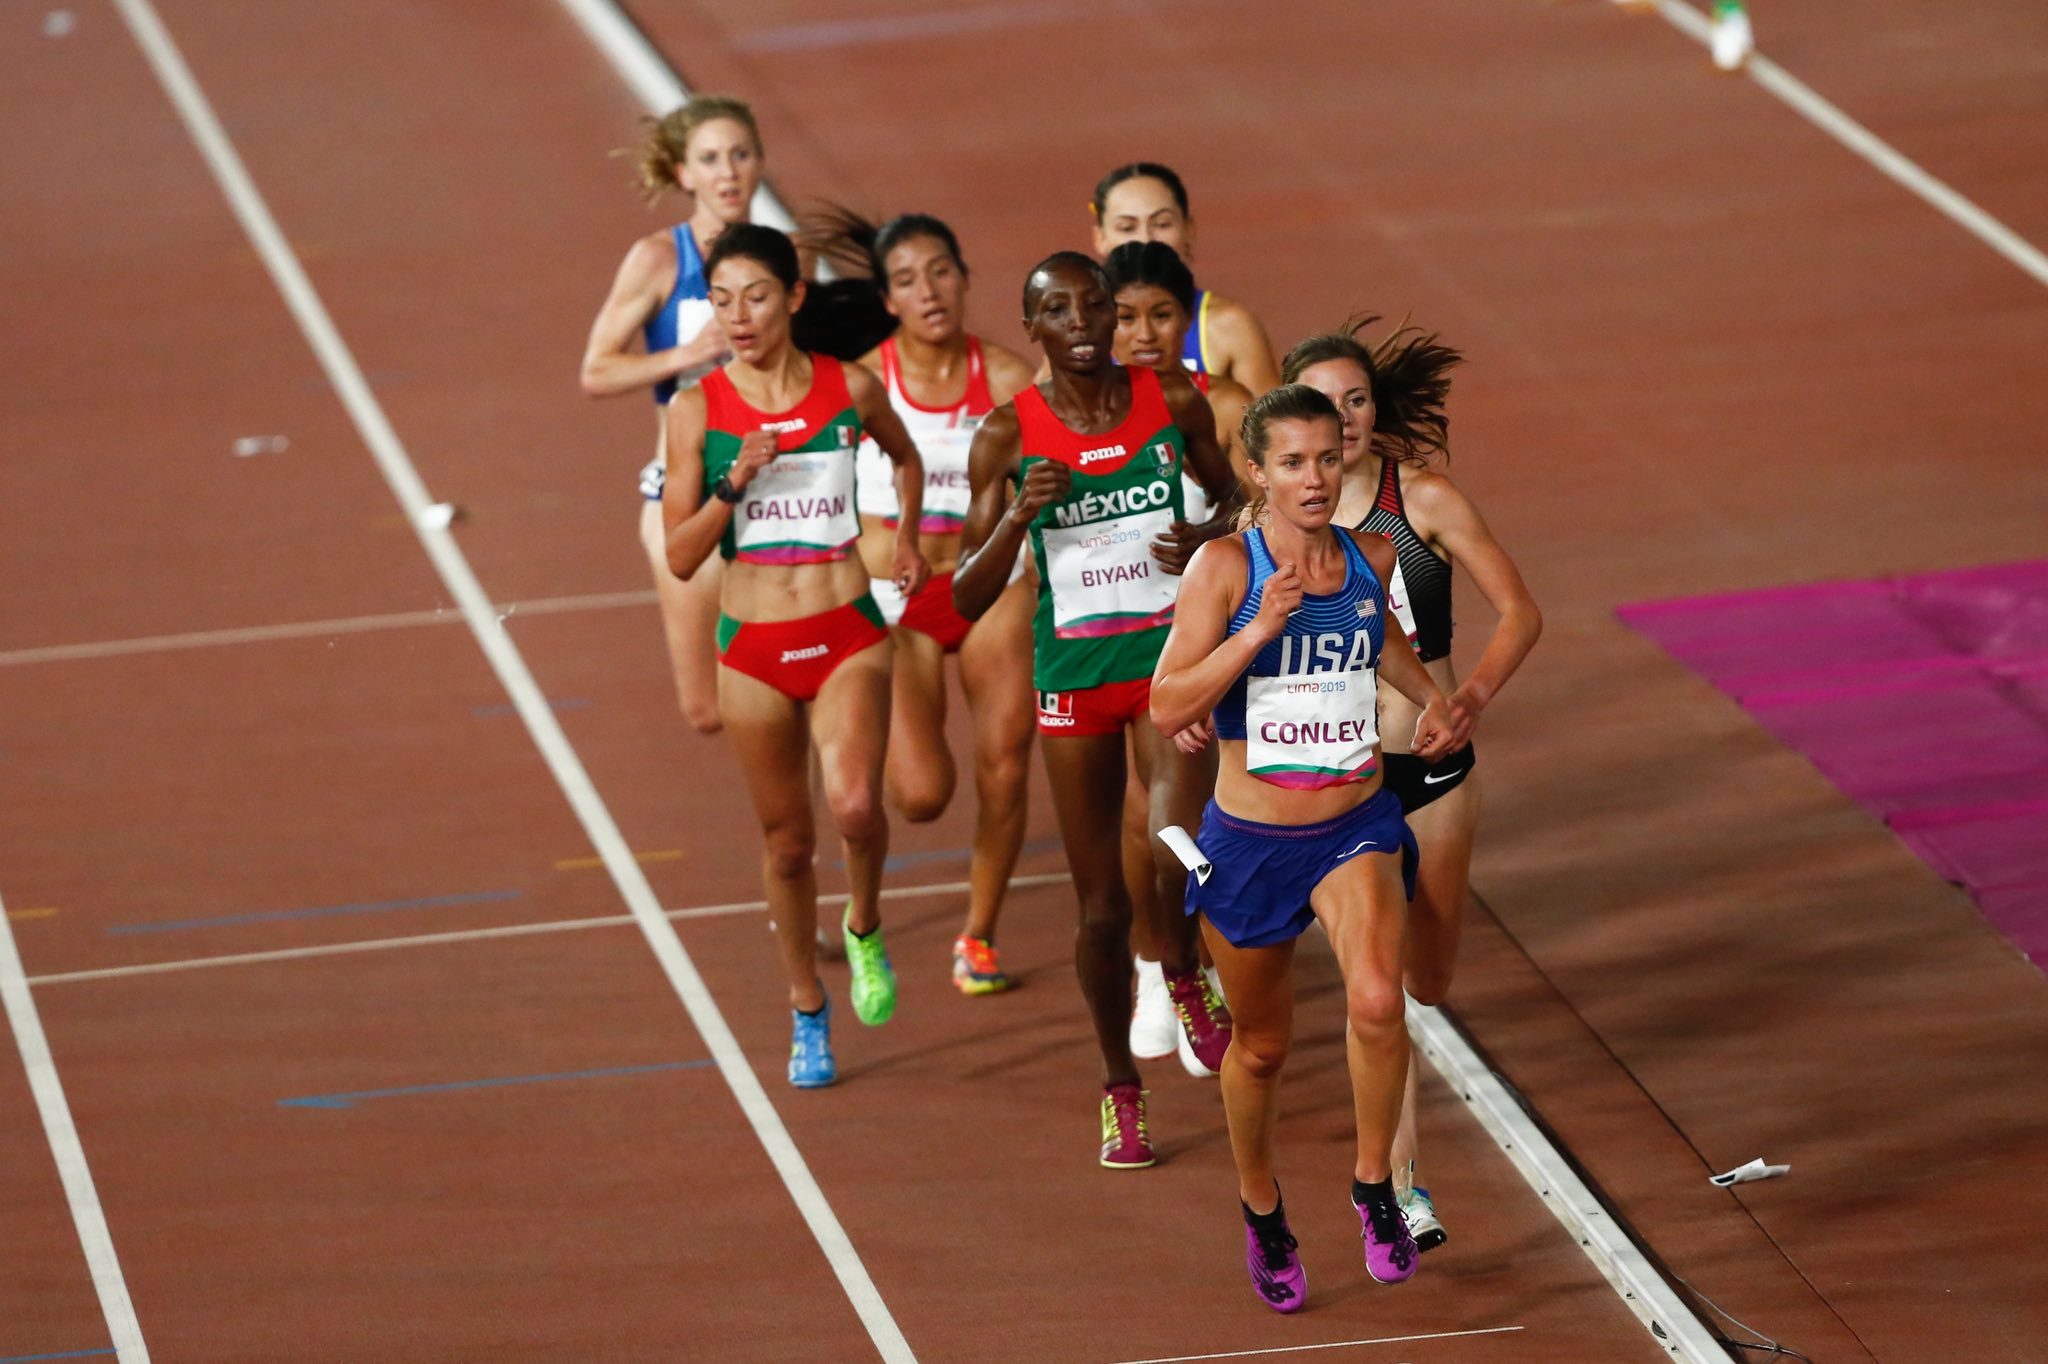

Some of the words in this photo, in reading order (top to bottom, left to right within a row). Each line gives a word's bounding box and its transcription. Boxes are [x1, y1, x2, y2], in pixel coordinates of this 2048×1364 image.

[746, 494, 846, 521] GALVAN
[1055, 480, 1170, 527] MÉXICO
[1081, 561, 1149, 587] BIYAKI
[1278, 629, 1371, 677] USA
[1260, 718, 1367, 745] CONLEY
